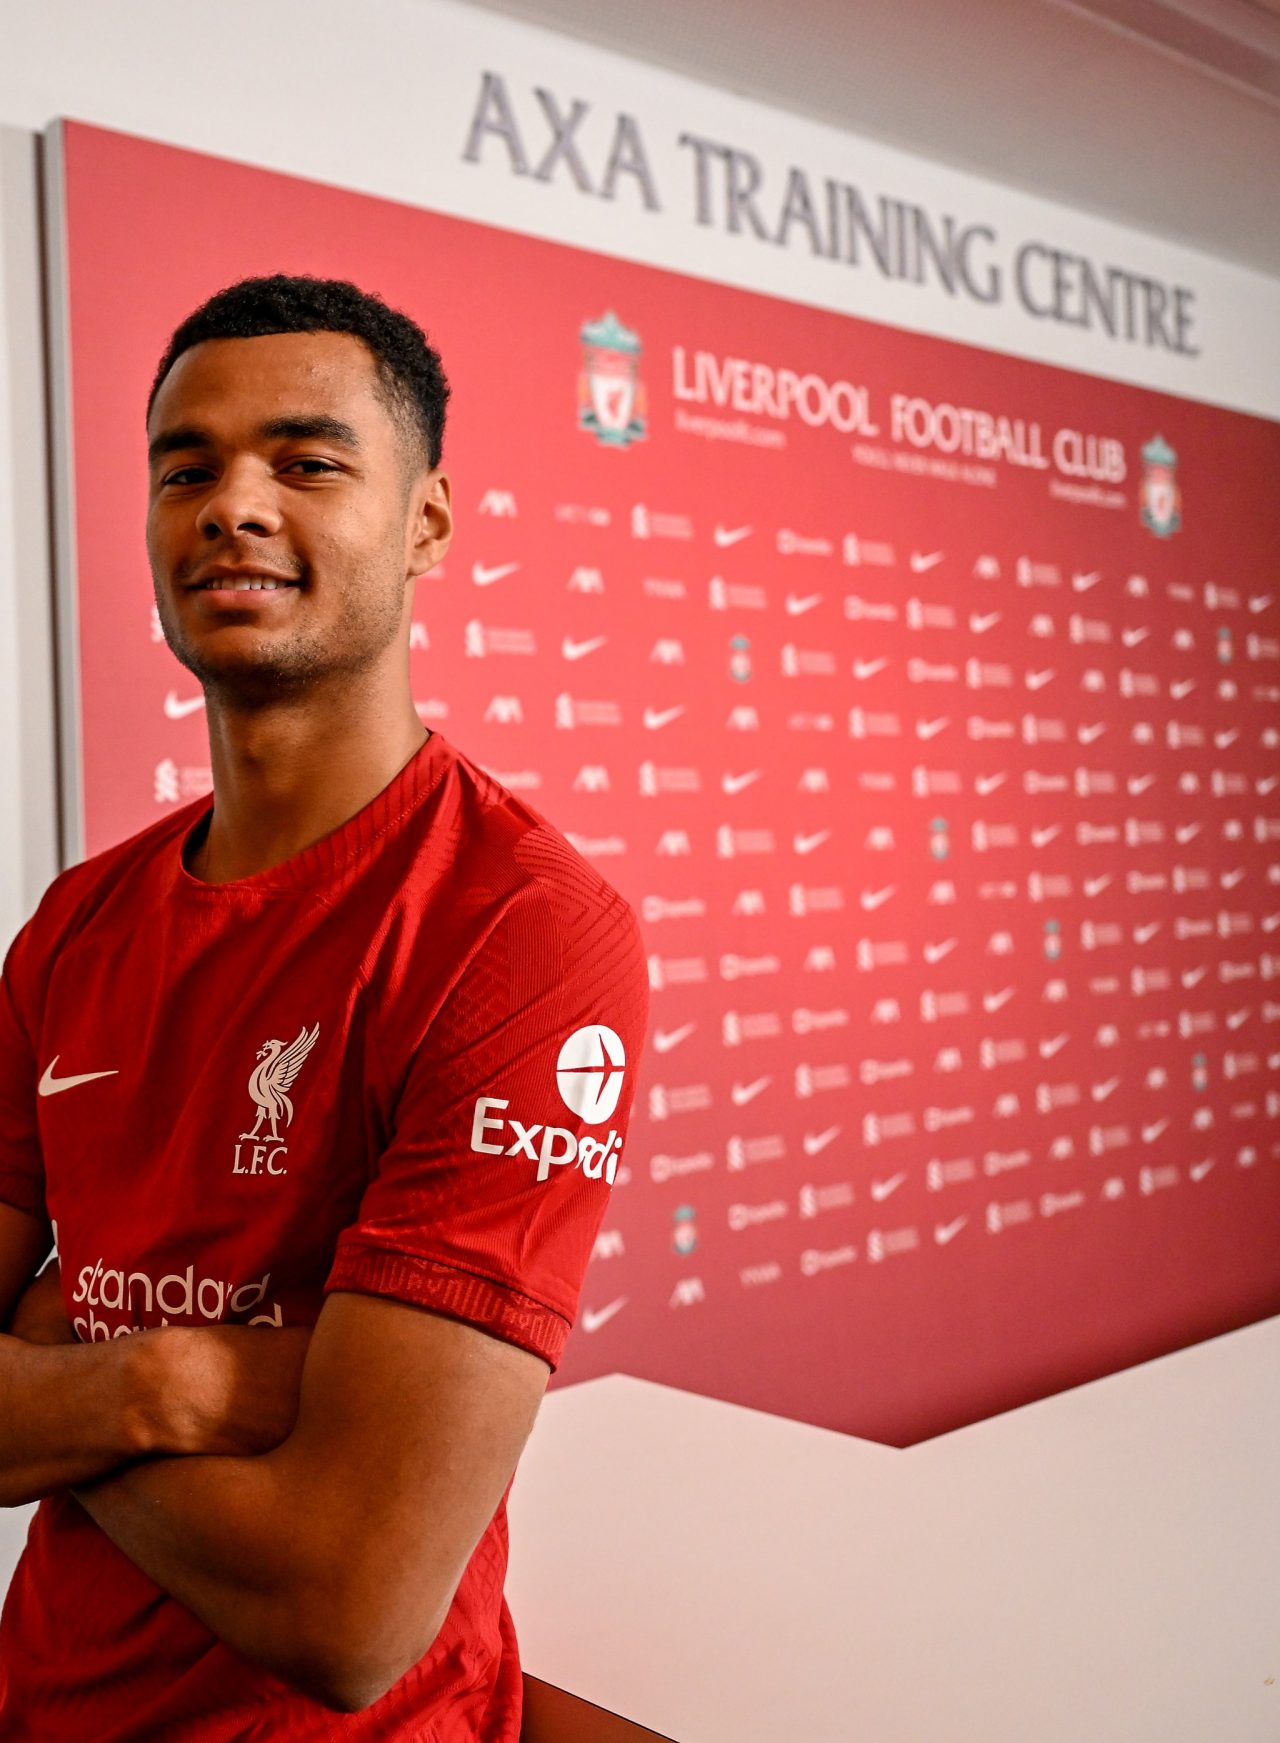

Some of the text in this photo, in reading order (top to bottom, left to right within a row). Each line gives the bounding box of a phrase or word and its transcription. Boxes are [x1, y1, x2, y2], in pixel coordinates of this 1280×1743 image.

[462, 70, 1202, 359] AXA TRAINING CENTRE
[673, 345, 880, 437] LIVERPOOL
[889, 393, 1050, 470] FOOTBALL
[1053, 427, 1127, 484] CLUB
[232, 1144, 288, 1175] L.F.C.
